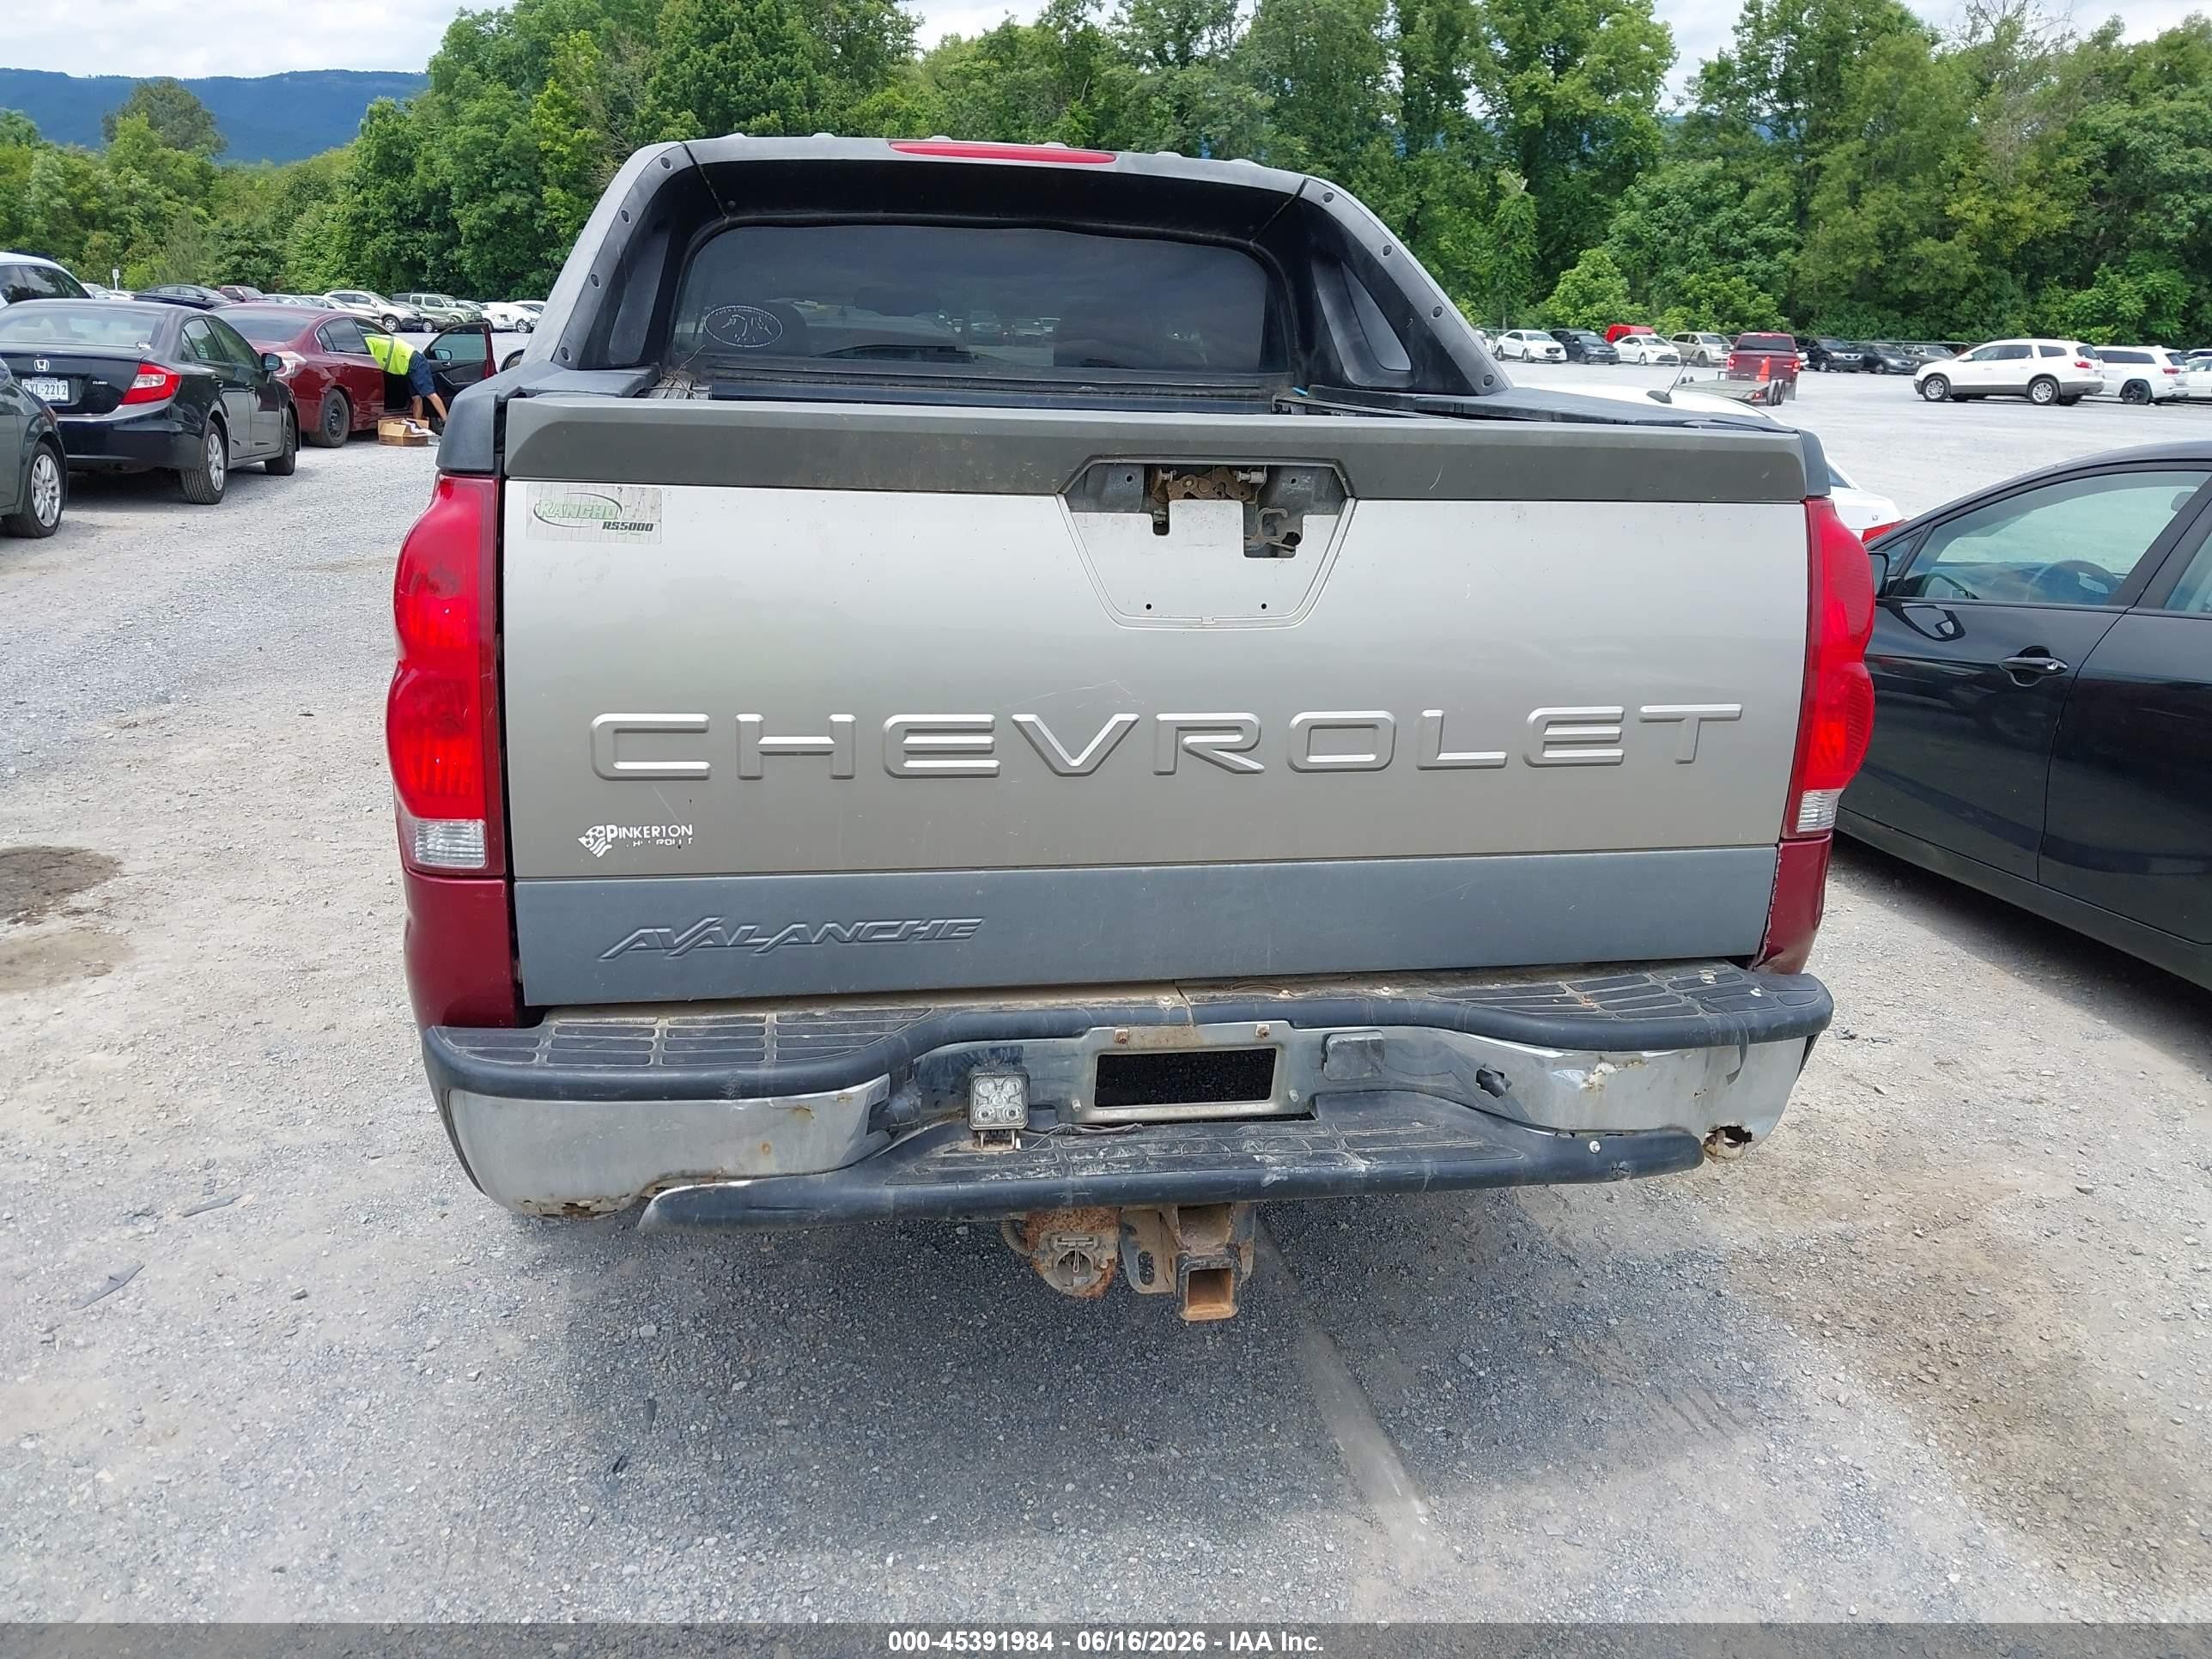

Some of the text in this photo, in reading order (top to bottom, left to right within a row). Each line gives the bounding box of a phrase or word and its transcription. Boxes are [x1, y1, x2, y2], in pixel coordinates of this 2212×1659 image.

[538, 500, 619, 520] RANCHO
[602, 520, 654, 532] RS5000
[589, 702, 1744, 782] CHEVROLET
[599, 916, 984, 960] AVALANCHE
